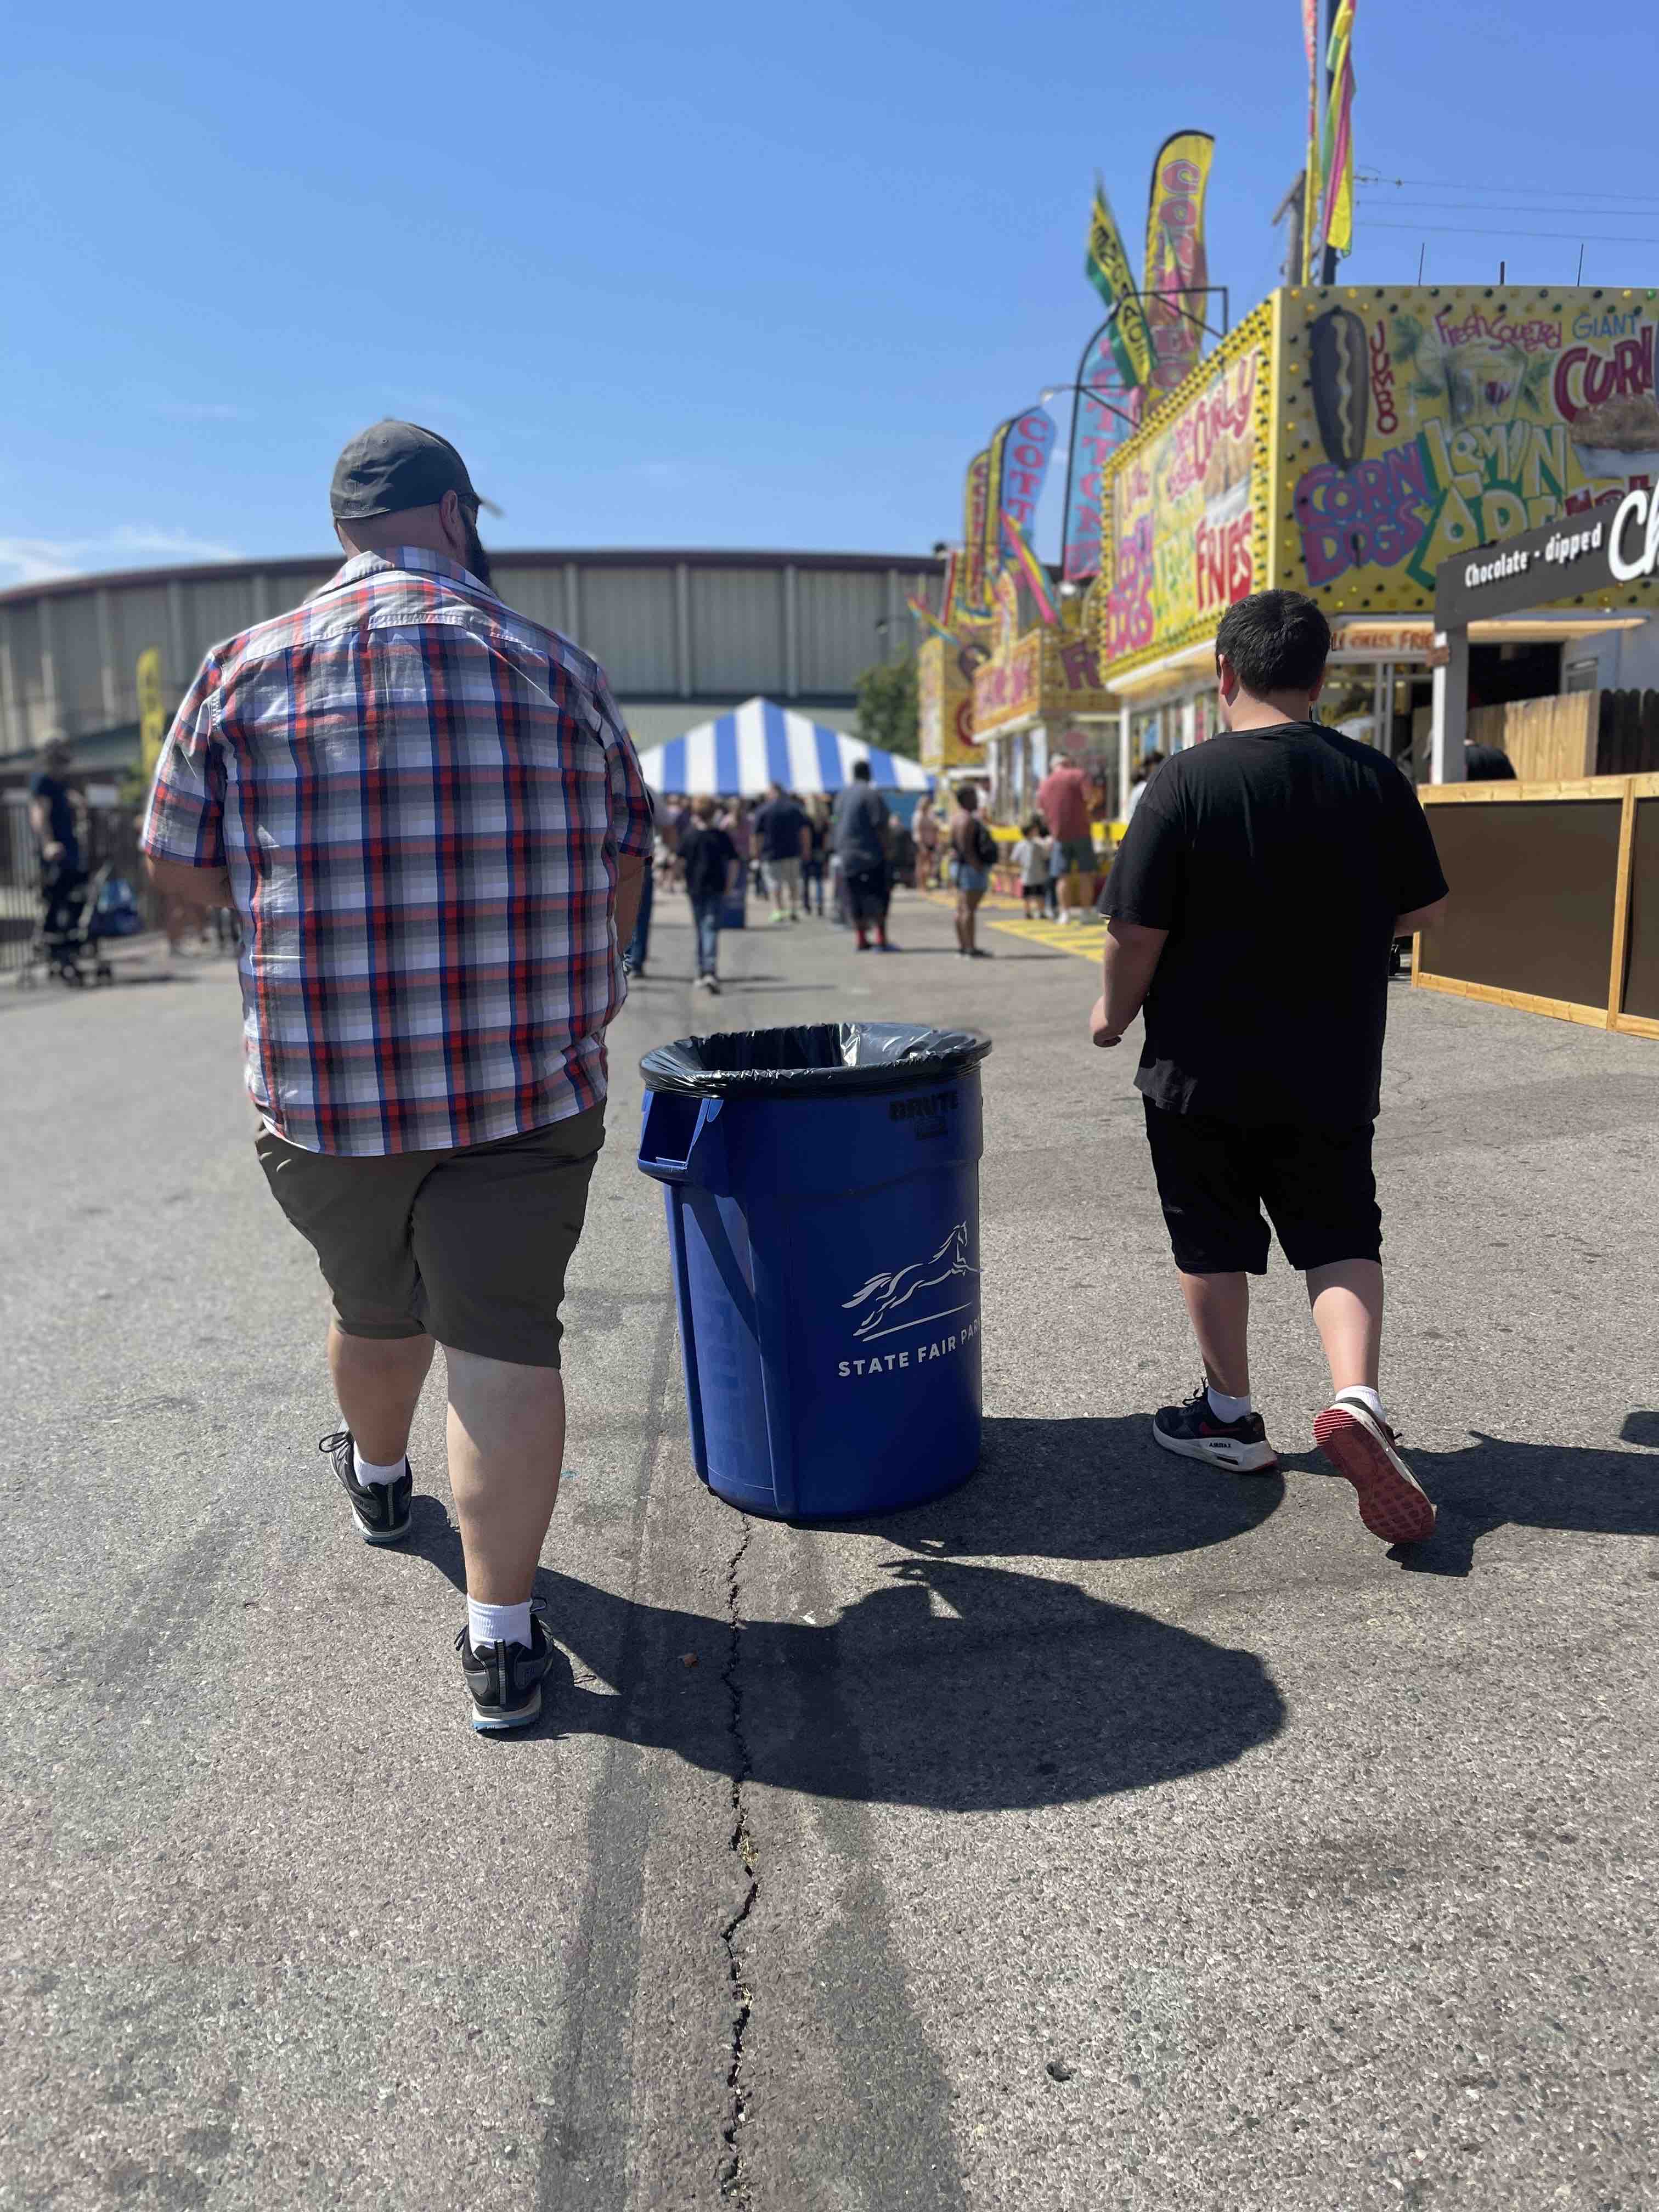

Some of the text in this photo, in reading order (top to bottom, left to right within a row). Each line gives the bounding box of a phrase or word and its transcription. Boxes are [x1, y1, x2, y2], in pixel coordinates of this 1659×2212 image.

[1572, 313, 1640, 340] GIANT
[1370, 320, 1398, 435] JUMBO
[1294, 441, 1433, 529] CORN
[1301, 496, 1428, 588] DOGS
[1464, 551, 1528, 588] Chocolate
[1544, 522, 1602, 564] dipped
[838, 1314, 980, 1377] STATE FAIR PAR
